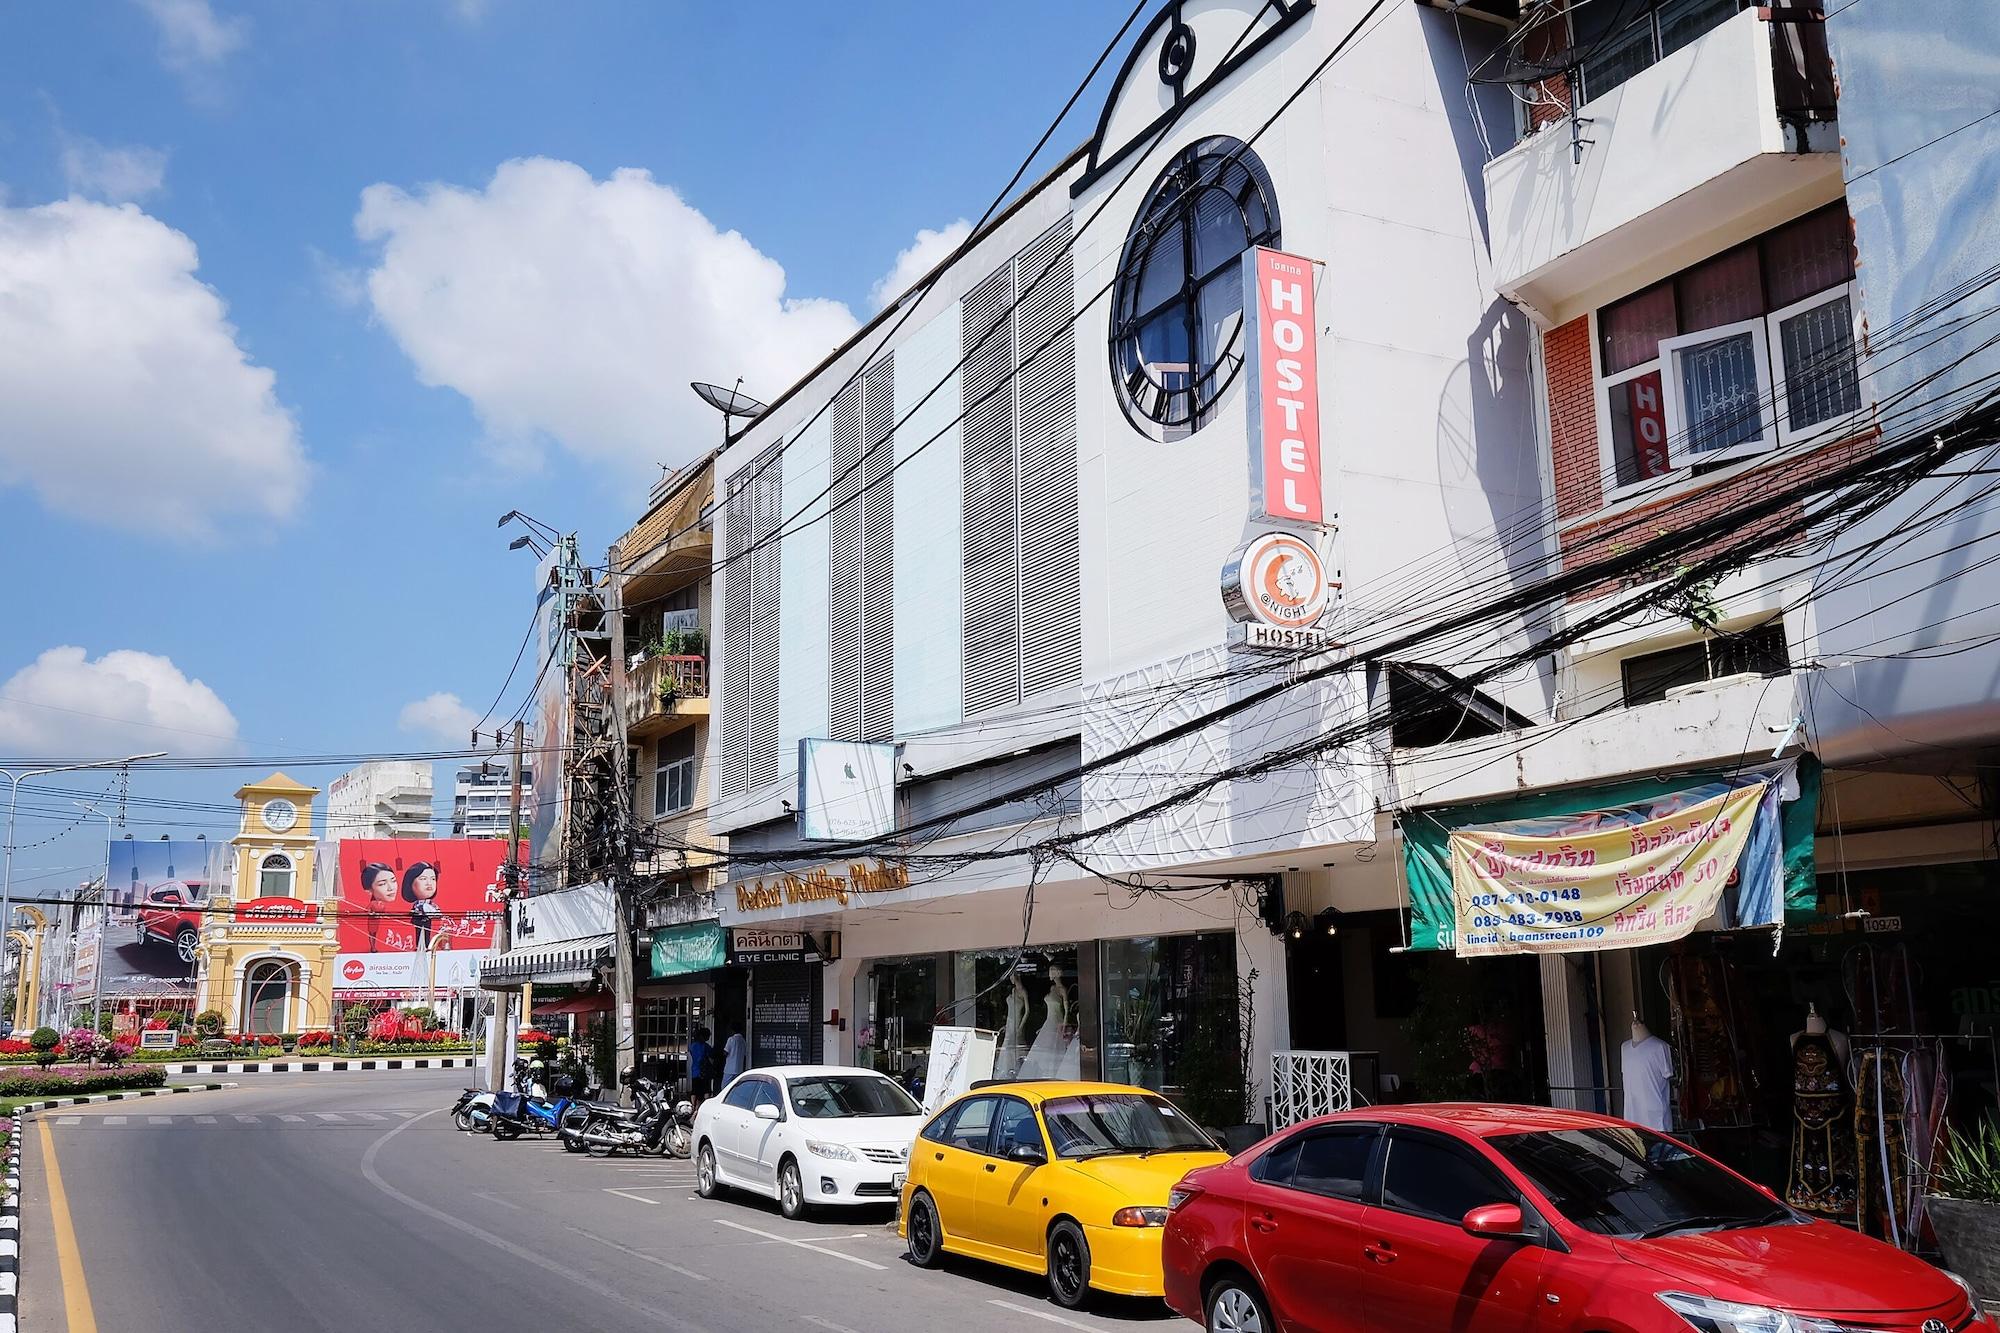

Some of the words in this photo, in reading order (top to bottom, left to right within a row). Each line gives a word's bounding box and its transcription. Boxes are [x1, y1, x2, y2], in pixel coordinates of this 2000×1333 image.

[1270, 278, 1307, 514] HOSTEL
[1260, 593, 1308, 618] @NIGHT
[1256, 627, 1322, 647] HOSTEL
[735, 880, 782, 912] Perfect
[782, 868, 848, 905] Wedding
[1865, 918, 1899, 931] 109/9
[736, 931, 801, 948] คลินิกตา
[1467, 932, 1498, 945] lineid
[738, 954, 760, 963] EYE
[763, 953, 800, 962] CLINIC
[368, 963, 410, 972] airasia.com
